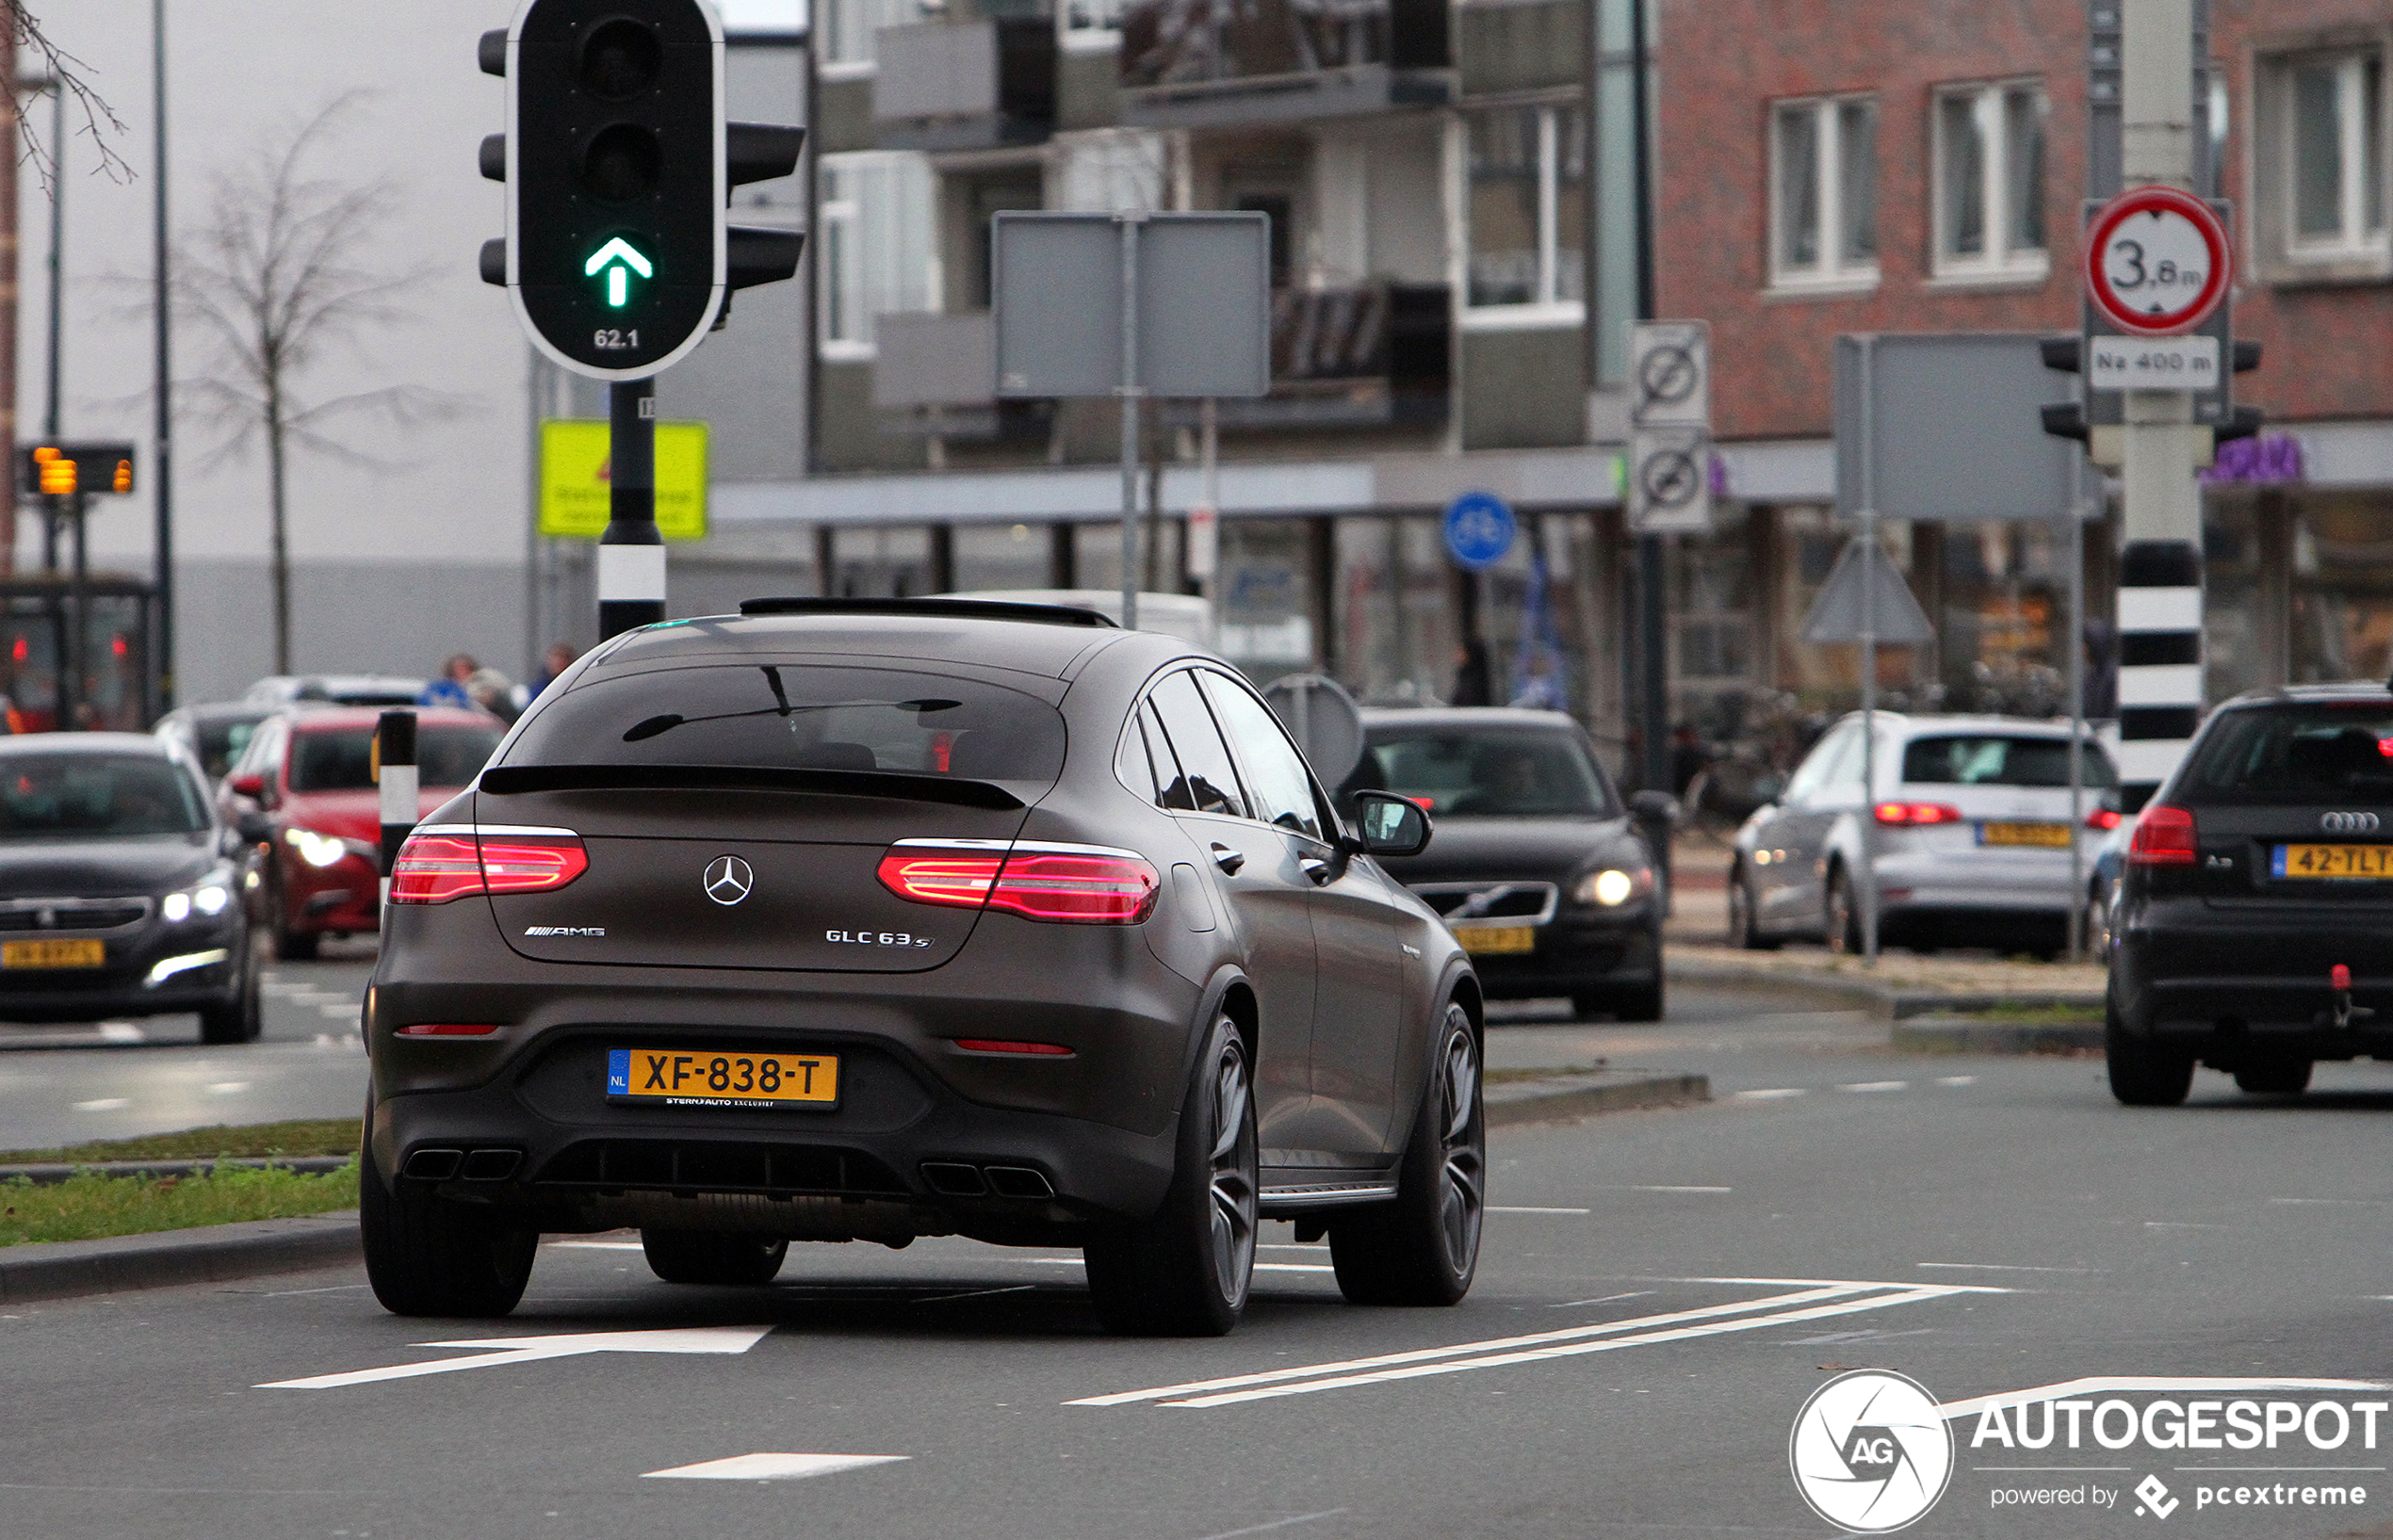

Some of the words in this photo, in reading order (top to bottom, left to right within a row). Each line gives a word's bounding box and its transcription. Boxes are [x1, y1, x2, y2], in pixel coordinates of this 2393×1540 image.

[594, 329, 639, 349] 62.1
[2096, 352, 2126, 370] Na
[2135, 352, 2184, 370] 400
[2192, 355, 2211, 370] m
[550, 927, 605, 937] AMG
[826, 930, 872, 944] GLC
[610, 1076, 626, 1086] NL
[644, 1055, 820, 1094] XF-838-T
